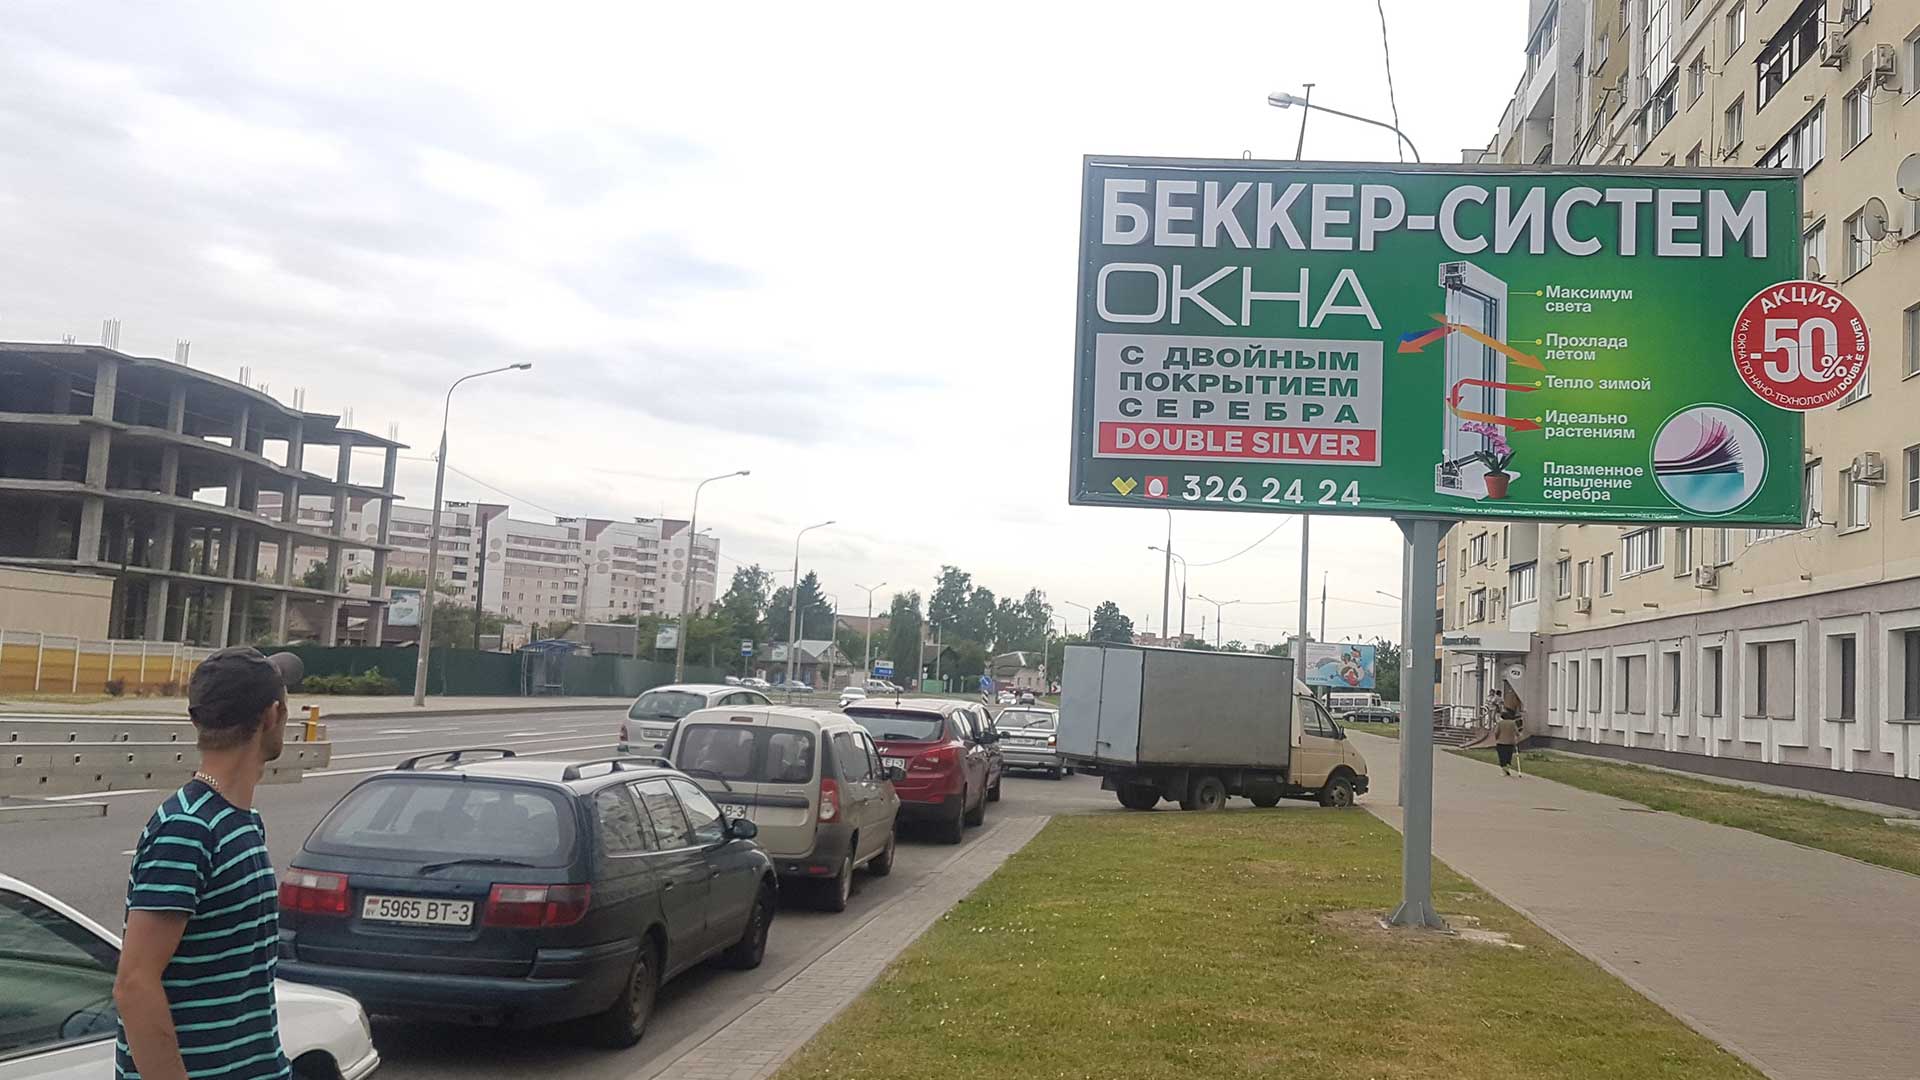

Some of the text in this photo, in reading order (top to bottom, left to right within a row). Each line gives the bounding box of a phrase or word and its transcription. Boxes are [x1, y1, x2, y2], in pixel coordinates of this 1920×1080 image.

[1102, 178, 1767, 258] БЕККЕР-СИСТЕМ
[1096, 263, 1382, 329] ОКНА
[1545, 285, 1633, 301] Максимум
[1760, 286, 1842, 314] АКЦИЯ
[1545, 301, 1592, 314] света
[1545, 334, 1628, 350] Прохлада
[1850, 317, 1866, 352] SILVER
[1545, 348, 1596, 361] летом
[1737, 333, 1747, 360] ОКНА
[1120, 344, 1359, 371] С ДВОЙНЫМ
[1741, 360, 1753, 375] ПО
[1545, 375, 1651, 390] Тепло зимой
[1839, 354, 1865, 391] DOUBLE
[1119, 372, 1358, 397] ПОКРЫТИЕМ
[1118, 398, 1359, 423] СЕРЕБРА
[1545, 410, 1628, 424] Идеально
[1115, 427, 1360, 456] DOUBLE SILVER
[1545, 426, 1635, 441] растениям
[1543, 461, 1643, 477] Плазменное
[1182, 475, 1361, 505] 326 24 24
[1543, 476, 1632, 489] напыление
[1543, 487, 1611, 501] серебра
[380, 900, 470, 921] 5965 BT-3
